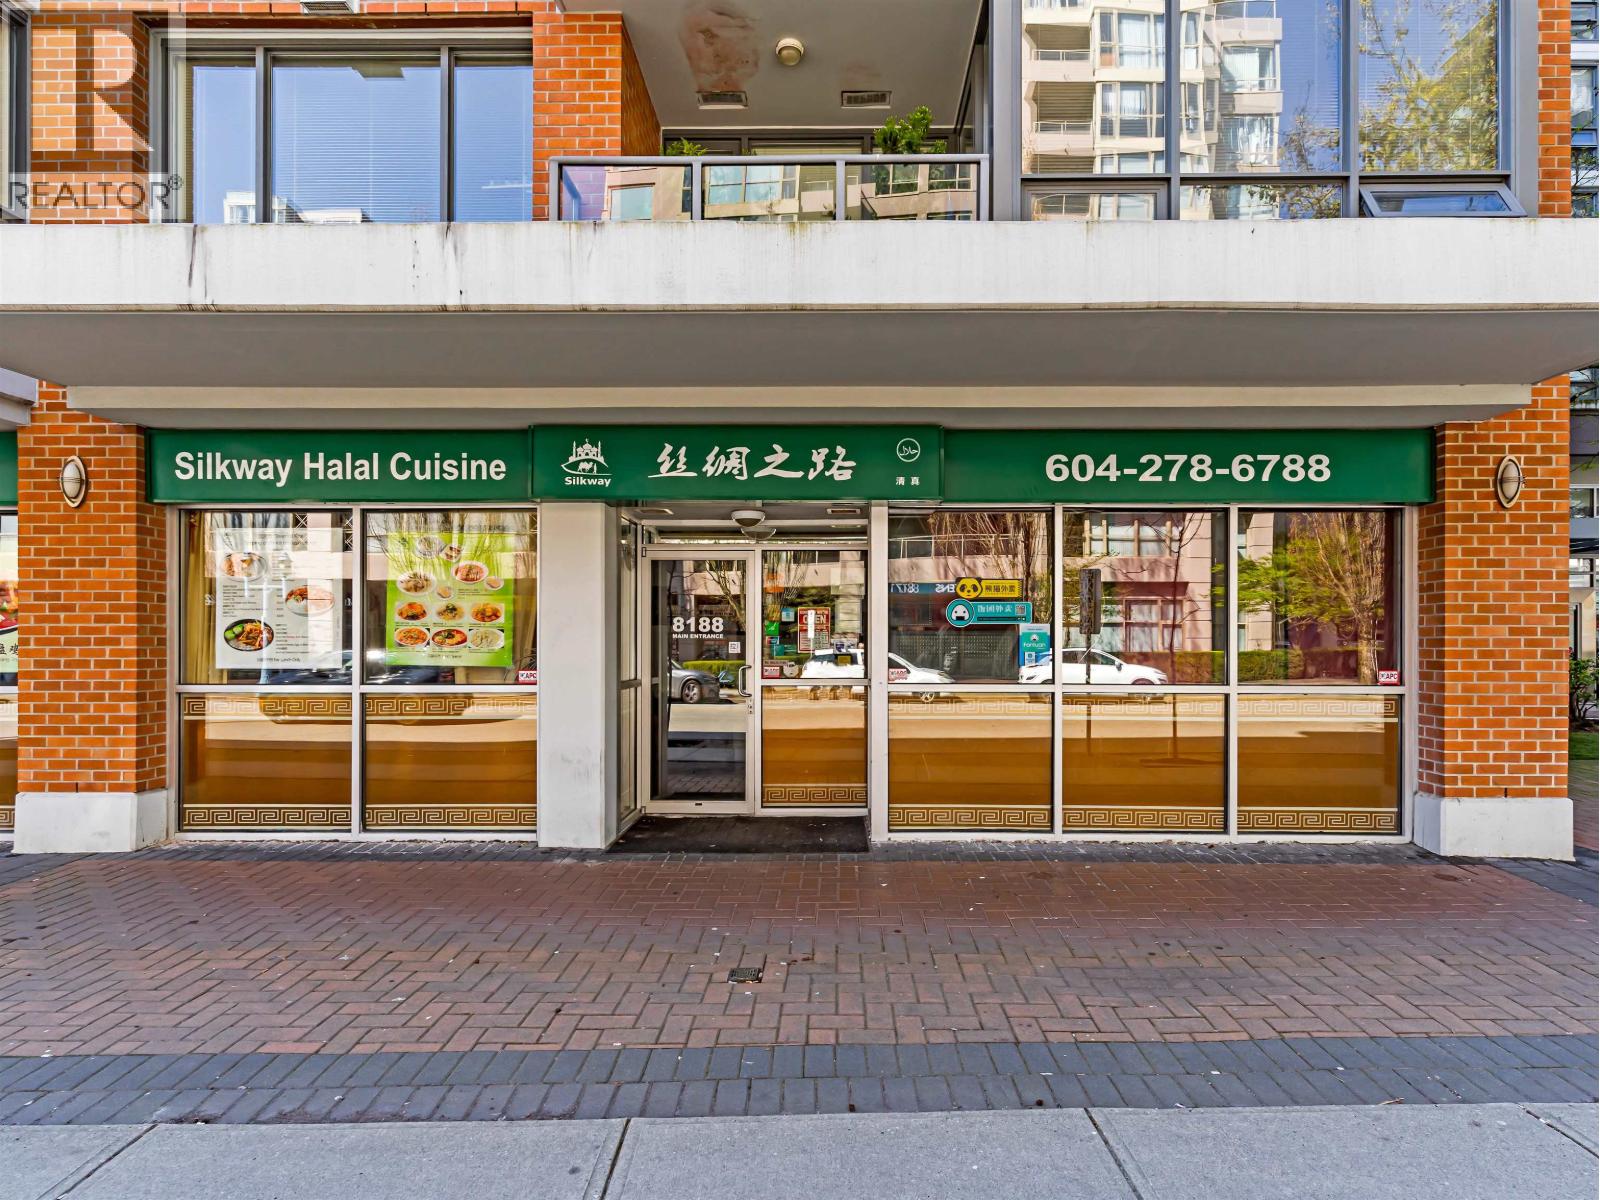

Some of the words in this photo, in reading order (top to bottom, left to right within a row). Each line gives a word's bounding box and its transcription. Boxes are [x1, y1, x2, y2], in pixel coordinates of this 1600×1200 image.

[174, 451, 293, 488] Silkway
[303, 452, 379, 480] Halal
[389, 451, 507, 481] Cuisine
[1045, 453, 1331, 482] 604-278-6788
[564, 475, 612, 488] Silkway
[672, 616, 724, 633] 8188
[802, 614, 827, 624] OEN
